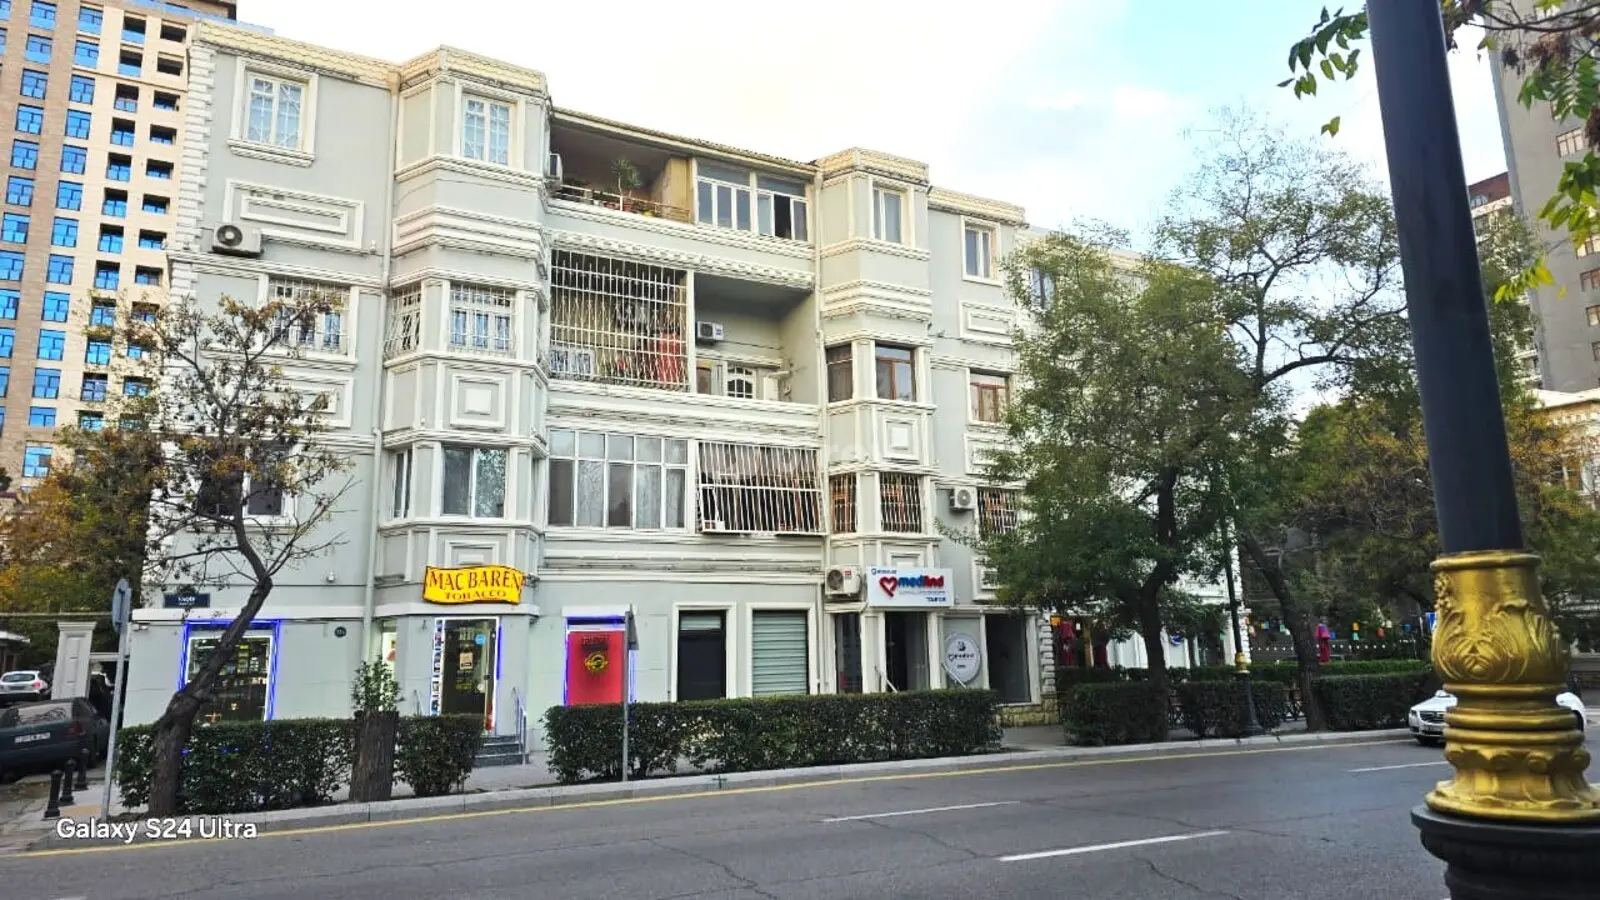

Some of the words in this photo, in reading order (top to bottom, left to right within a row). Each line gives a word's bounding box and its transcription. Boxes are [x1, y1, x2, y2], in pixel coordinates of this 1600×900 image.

[429, 570, 464, 591] MAC
[468, 570, 526, 590] BAREN
[445, 589, 507, 600] TOBACCO
